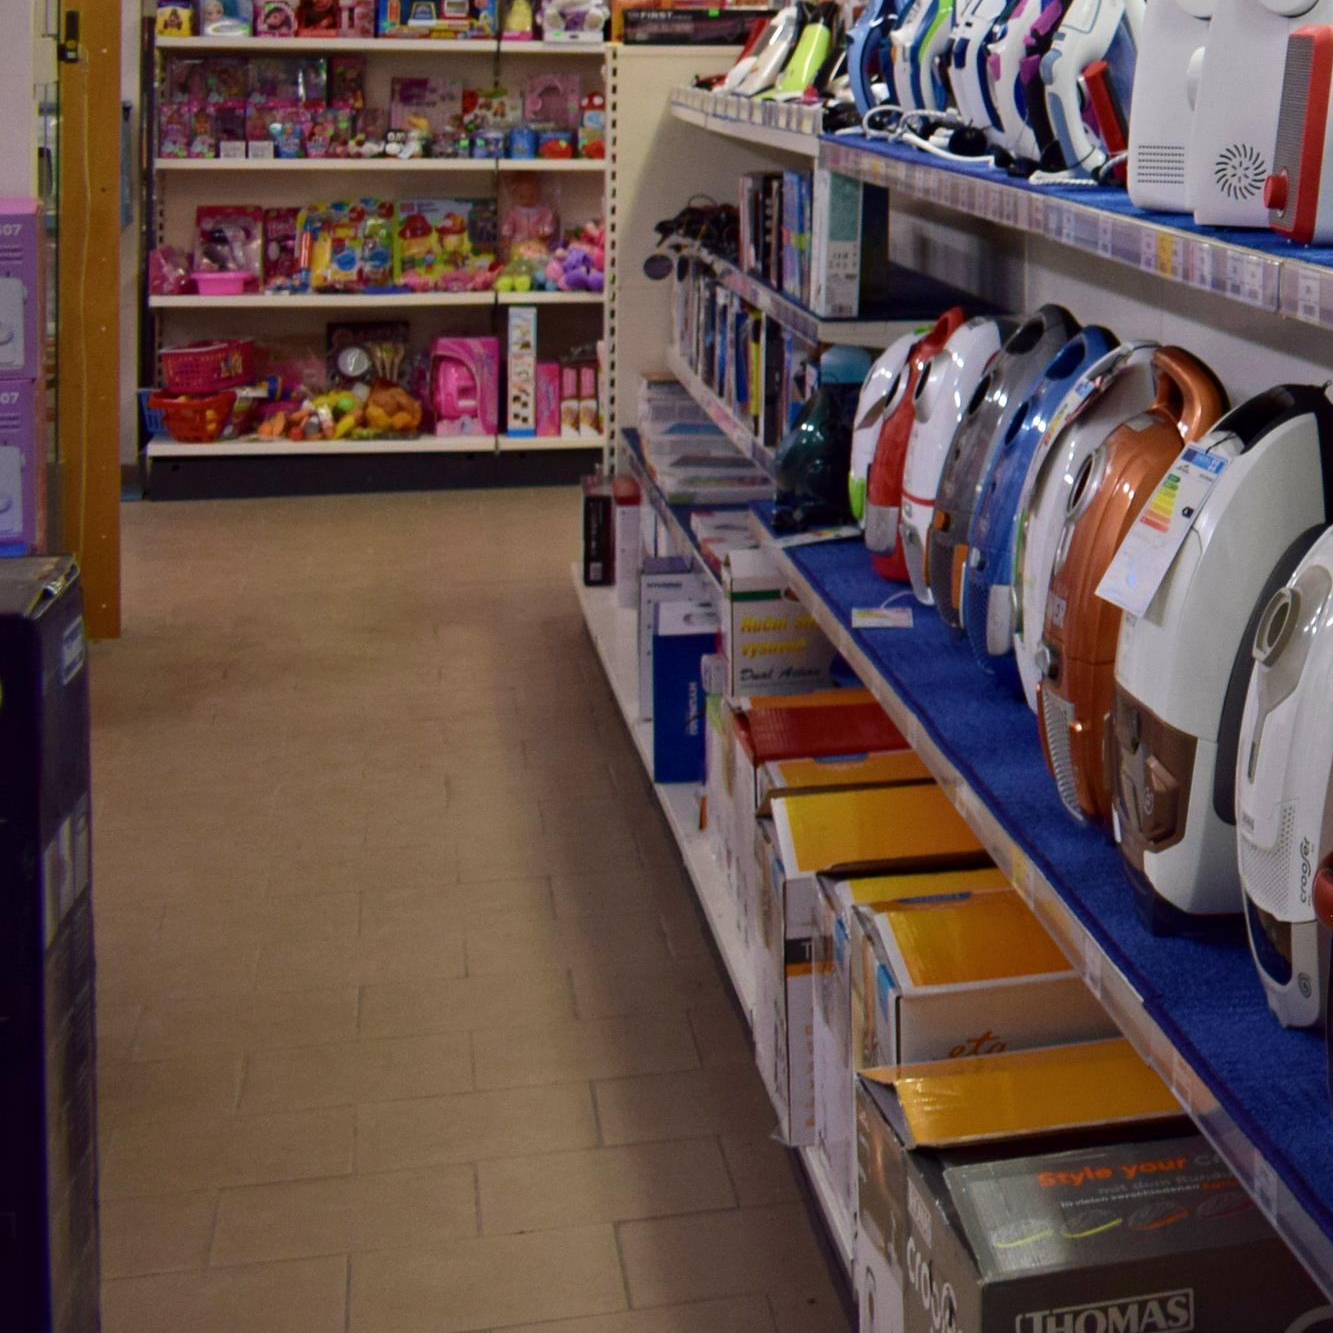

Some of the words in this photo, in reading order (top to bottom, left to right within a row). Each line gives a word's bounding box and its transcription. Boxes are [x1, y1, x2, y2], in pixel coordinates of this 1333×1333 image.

[739, 666, 773, 682] Dual
[948, 1030, 1008, 1060] eta
[1037, 1164, 1114, 1189] Style
[1121, 1156, 1188, 1180] your
[1075, 1194, 1109, 1207] vielen
[1110, 1183, 1200, 1202] verschiedenen
[1026, 1295, 1190, 1333] THOMAS
